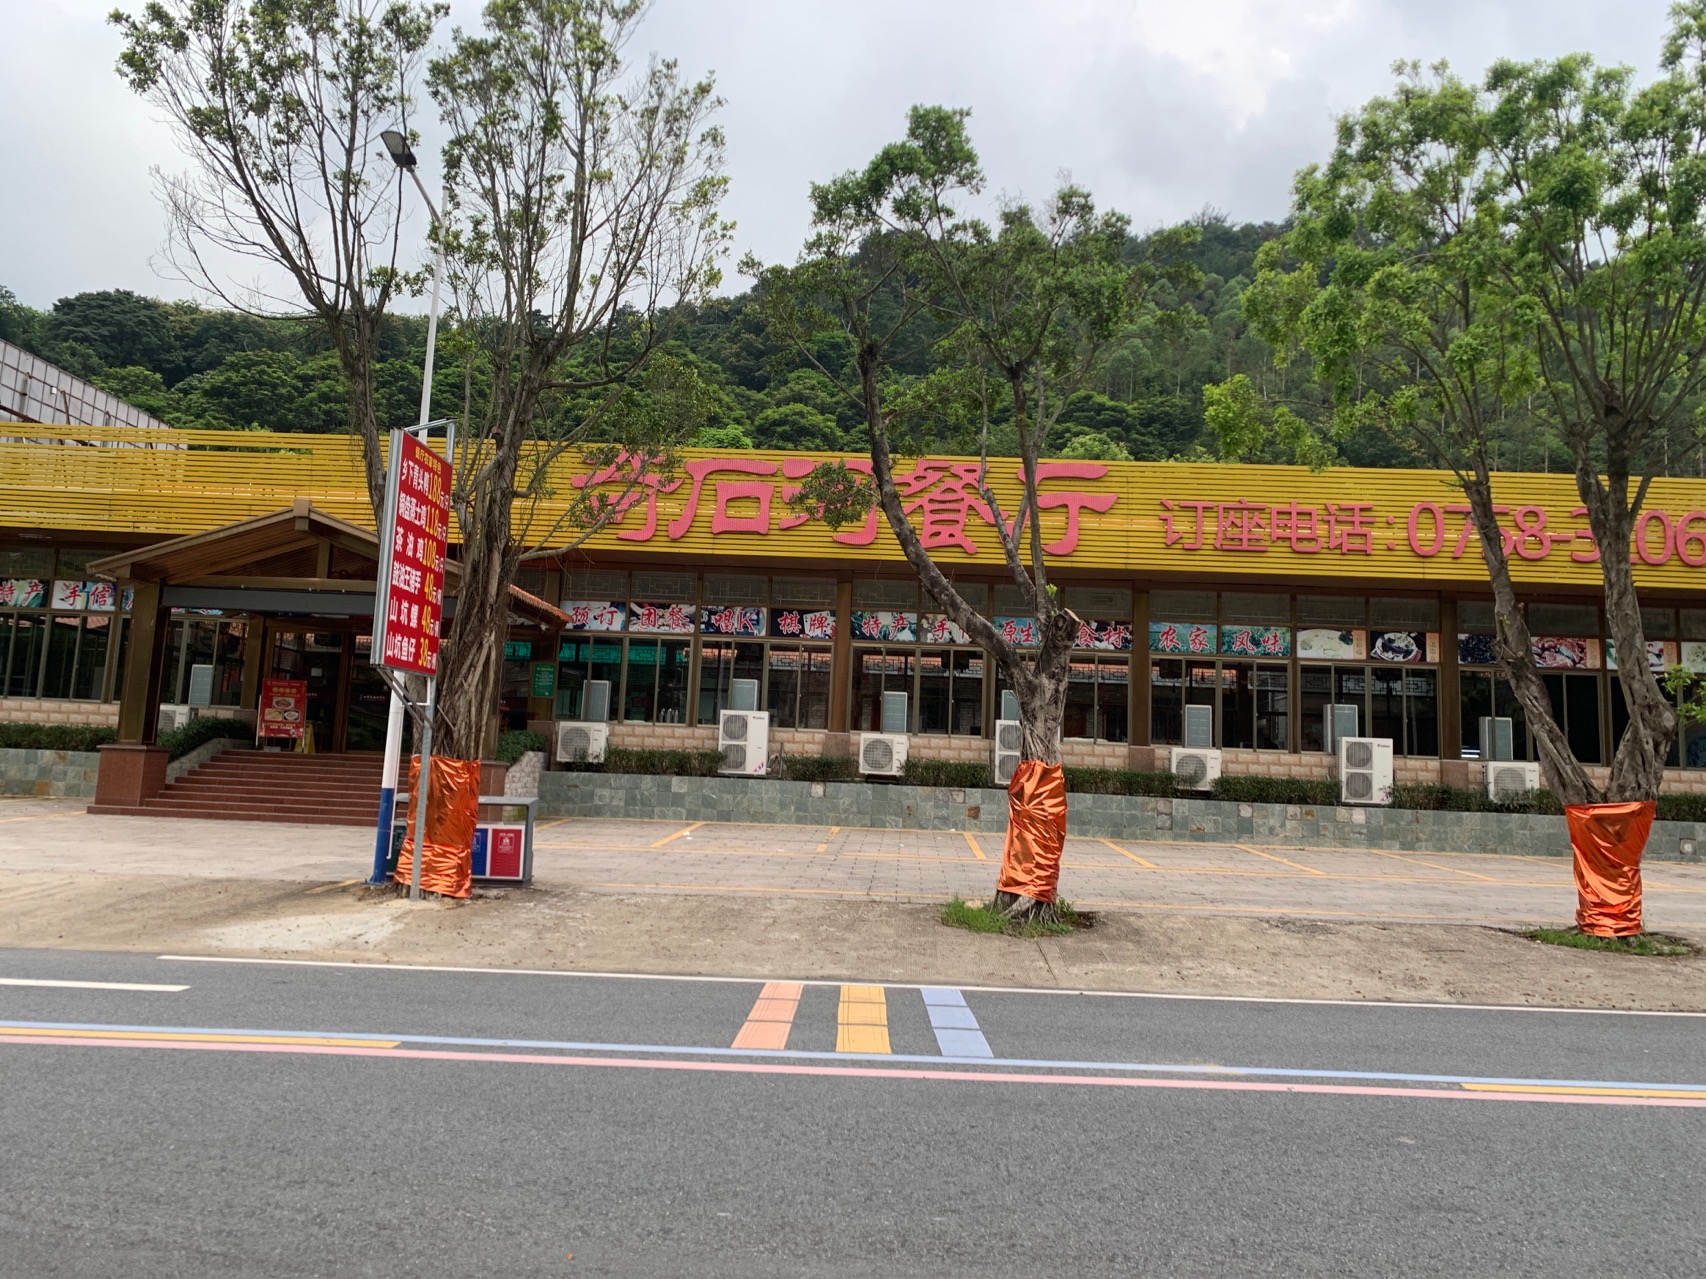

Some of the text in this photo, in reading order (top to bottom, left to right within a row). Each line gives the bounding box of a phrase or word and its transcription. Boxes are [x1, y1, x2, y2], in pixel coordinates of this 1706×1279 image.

[63, 583, 111, 607] 手信
[571, 606, 618, 627] 预订
[640, 607, 690, 630] 团餐
[714, 609, 756, 633] 唱K
[778, 611, 828, 634] 棋牌
[861, 615, 910, 640] 特产
[1075, 623, 1127, 647] 食材
[1159, 626, 1210, 651] 农家
[1231, 629, 1285, 653] 风味
